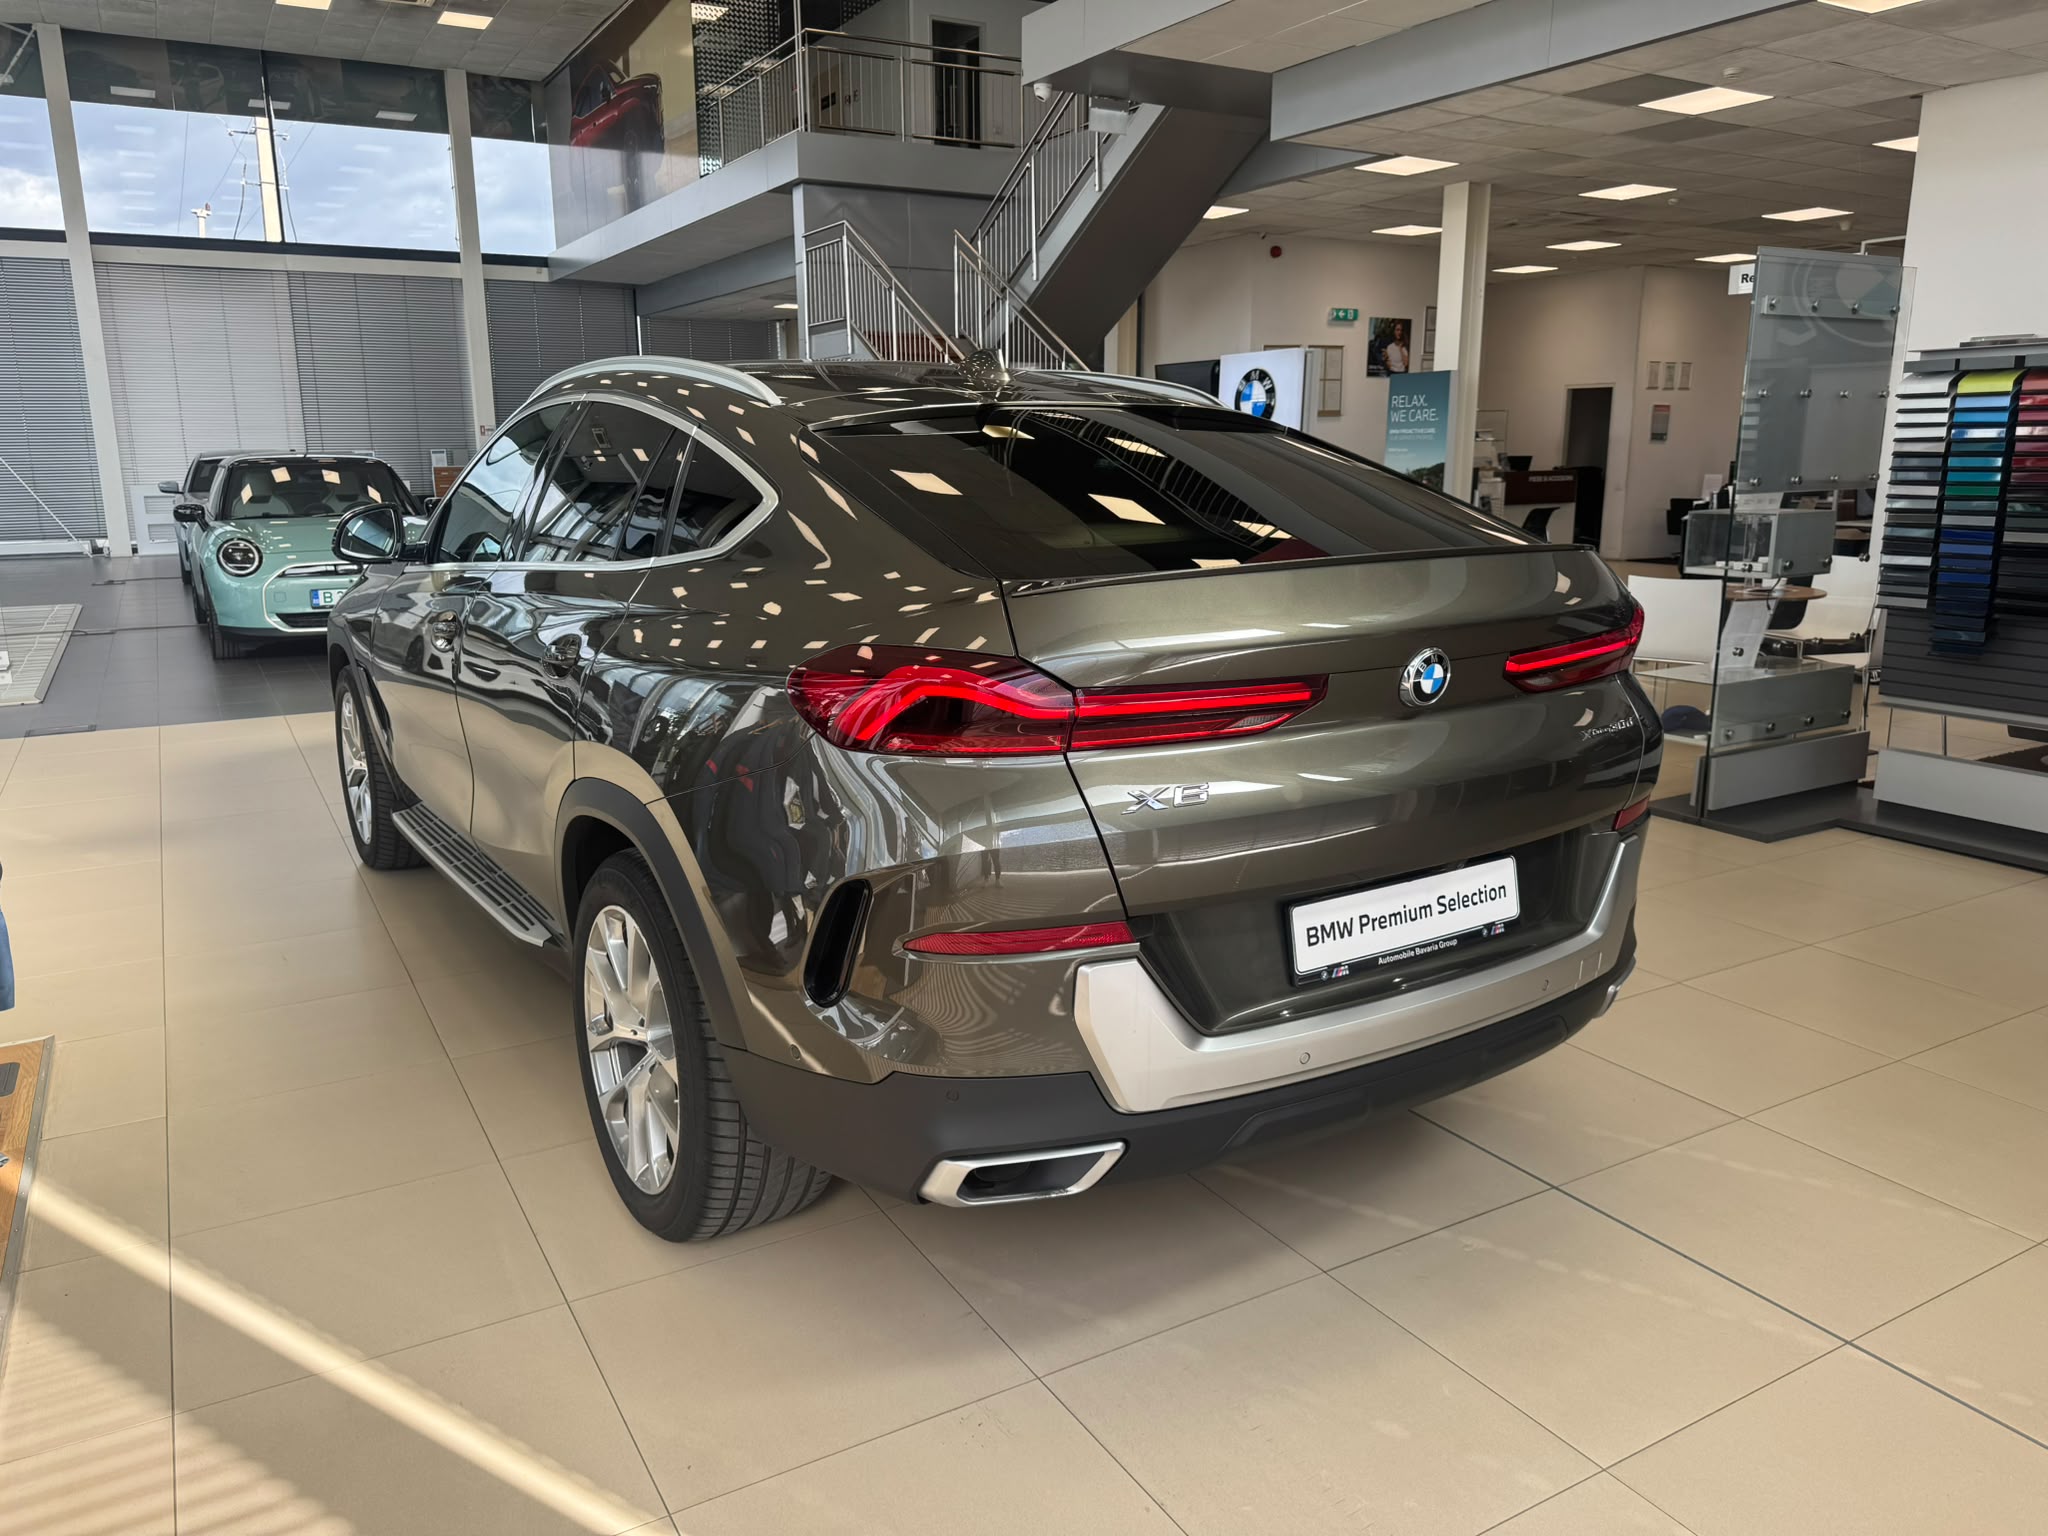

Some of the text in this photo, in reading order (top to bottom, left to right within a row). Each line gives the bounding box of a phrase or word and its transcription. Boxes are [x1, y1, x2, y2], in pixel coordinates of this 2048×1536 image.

[1391, 394, 1428, 408] RELAX.
[1390, 408, 1439, 422] WE CARE.
[323, 591, 334, 604] B
[1120, 782, 1209, 815] X6
[1306, 884, 1507, 947] BMW Premium Selection
[1377, 937, 1458, 965] Automobile Bavaria Group
